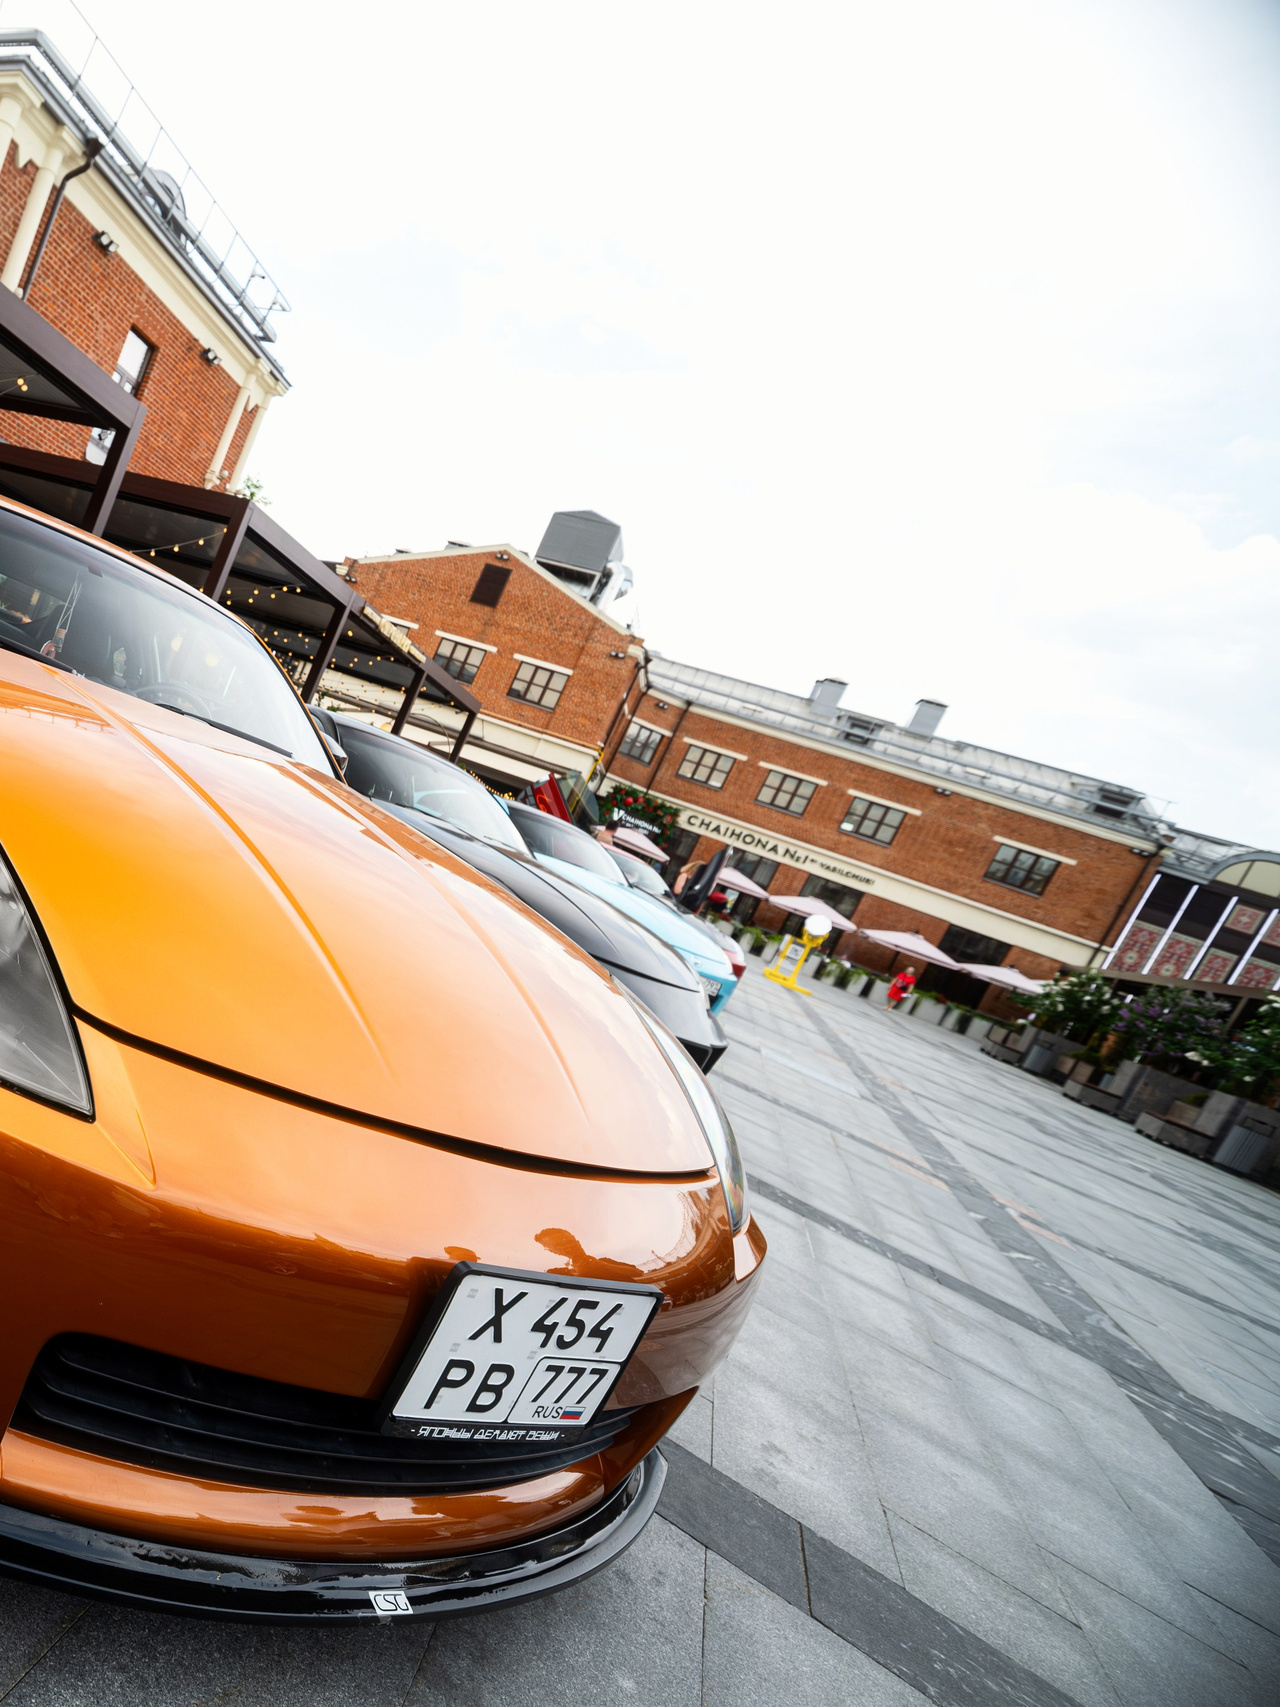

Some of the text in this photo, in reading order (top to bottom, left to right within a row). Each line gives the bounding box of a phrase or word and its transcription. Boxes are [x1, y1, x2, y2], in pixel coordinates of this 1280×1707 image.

[687, 815, 779, 856] CHAIHONA
[530, 1297, 624, 1353] 454
[531, 1364, 609, 1404] 777
[531, 1405, 563, 1419] RUS
[473, 1429, 527, 1441] ДЕЛАЮТ
